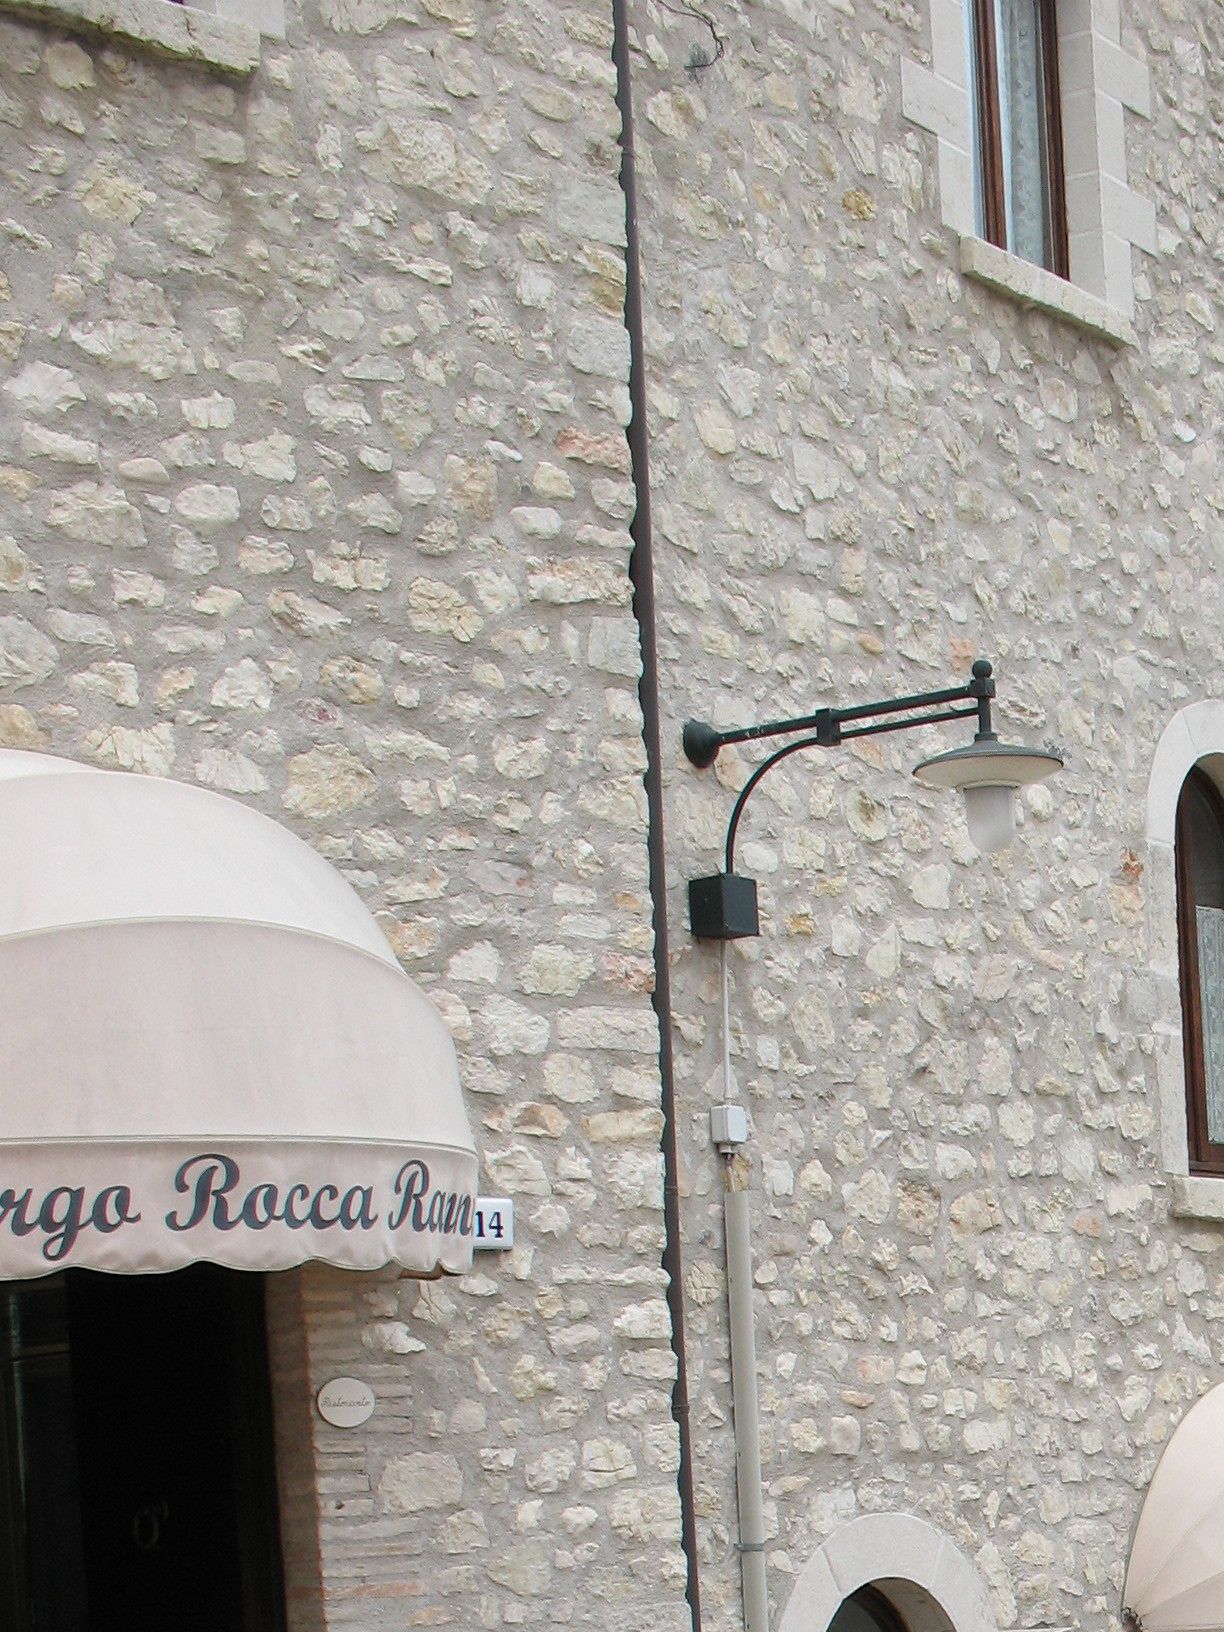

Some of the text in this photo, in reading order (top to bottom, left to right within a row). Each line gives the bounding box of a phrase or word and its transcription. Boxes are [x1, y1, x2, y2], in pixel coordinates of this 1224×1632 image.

[0, 1186, 142, 1261] rgo
[165, 1153, 379, 1232] Rocca
[474, 1210, 504, 1238] 14
